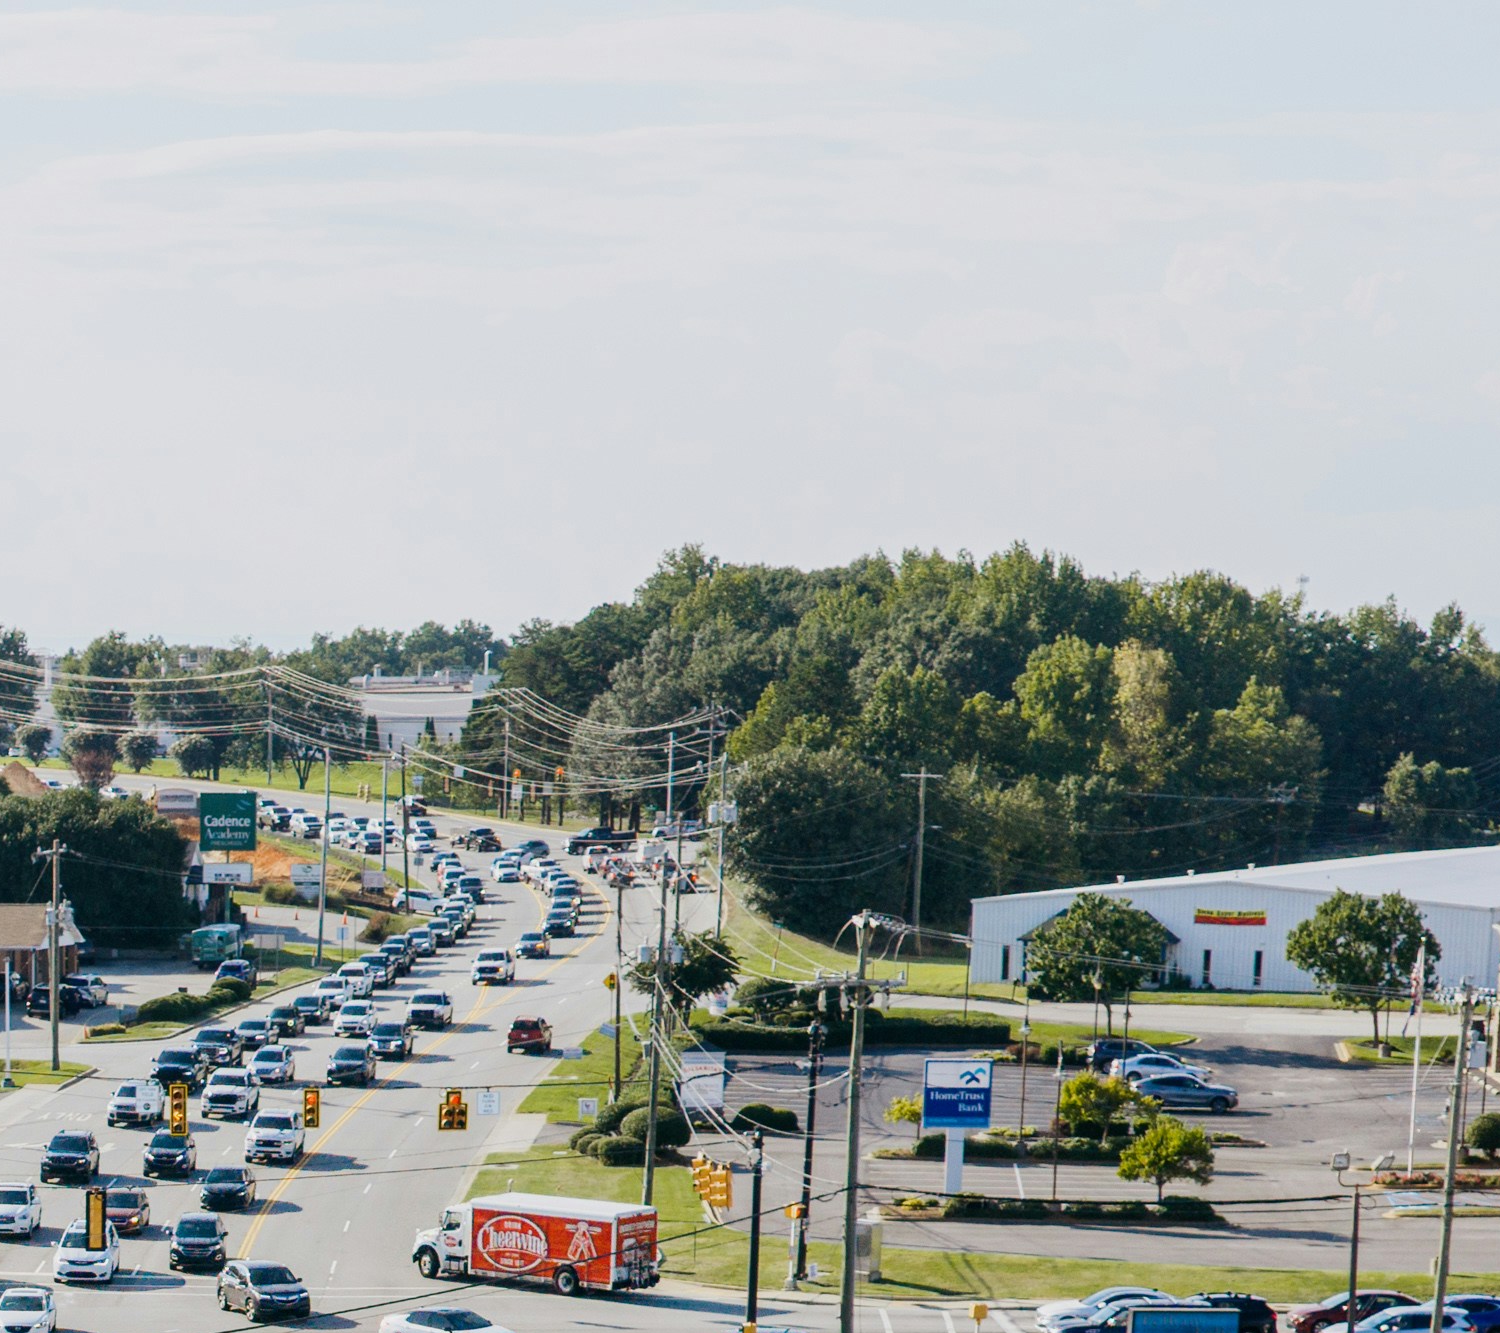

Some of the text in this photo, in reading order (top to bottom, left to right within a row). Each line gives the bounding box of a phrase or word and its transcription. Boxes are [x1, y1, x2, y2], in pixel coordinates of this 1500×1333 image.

[204, 814, 251, 826] Cadence
[204, 828, 250, 841] Academy
[930, 1091, 984, 1100] HomeTrust
[957, 1102, 984, 1112] Bank
[477, 1222, 549, 1256] Cheerwine
